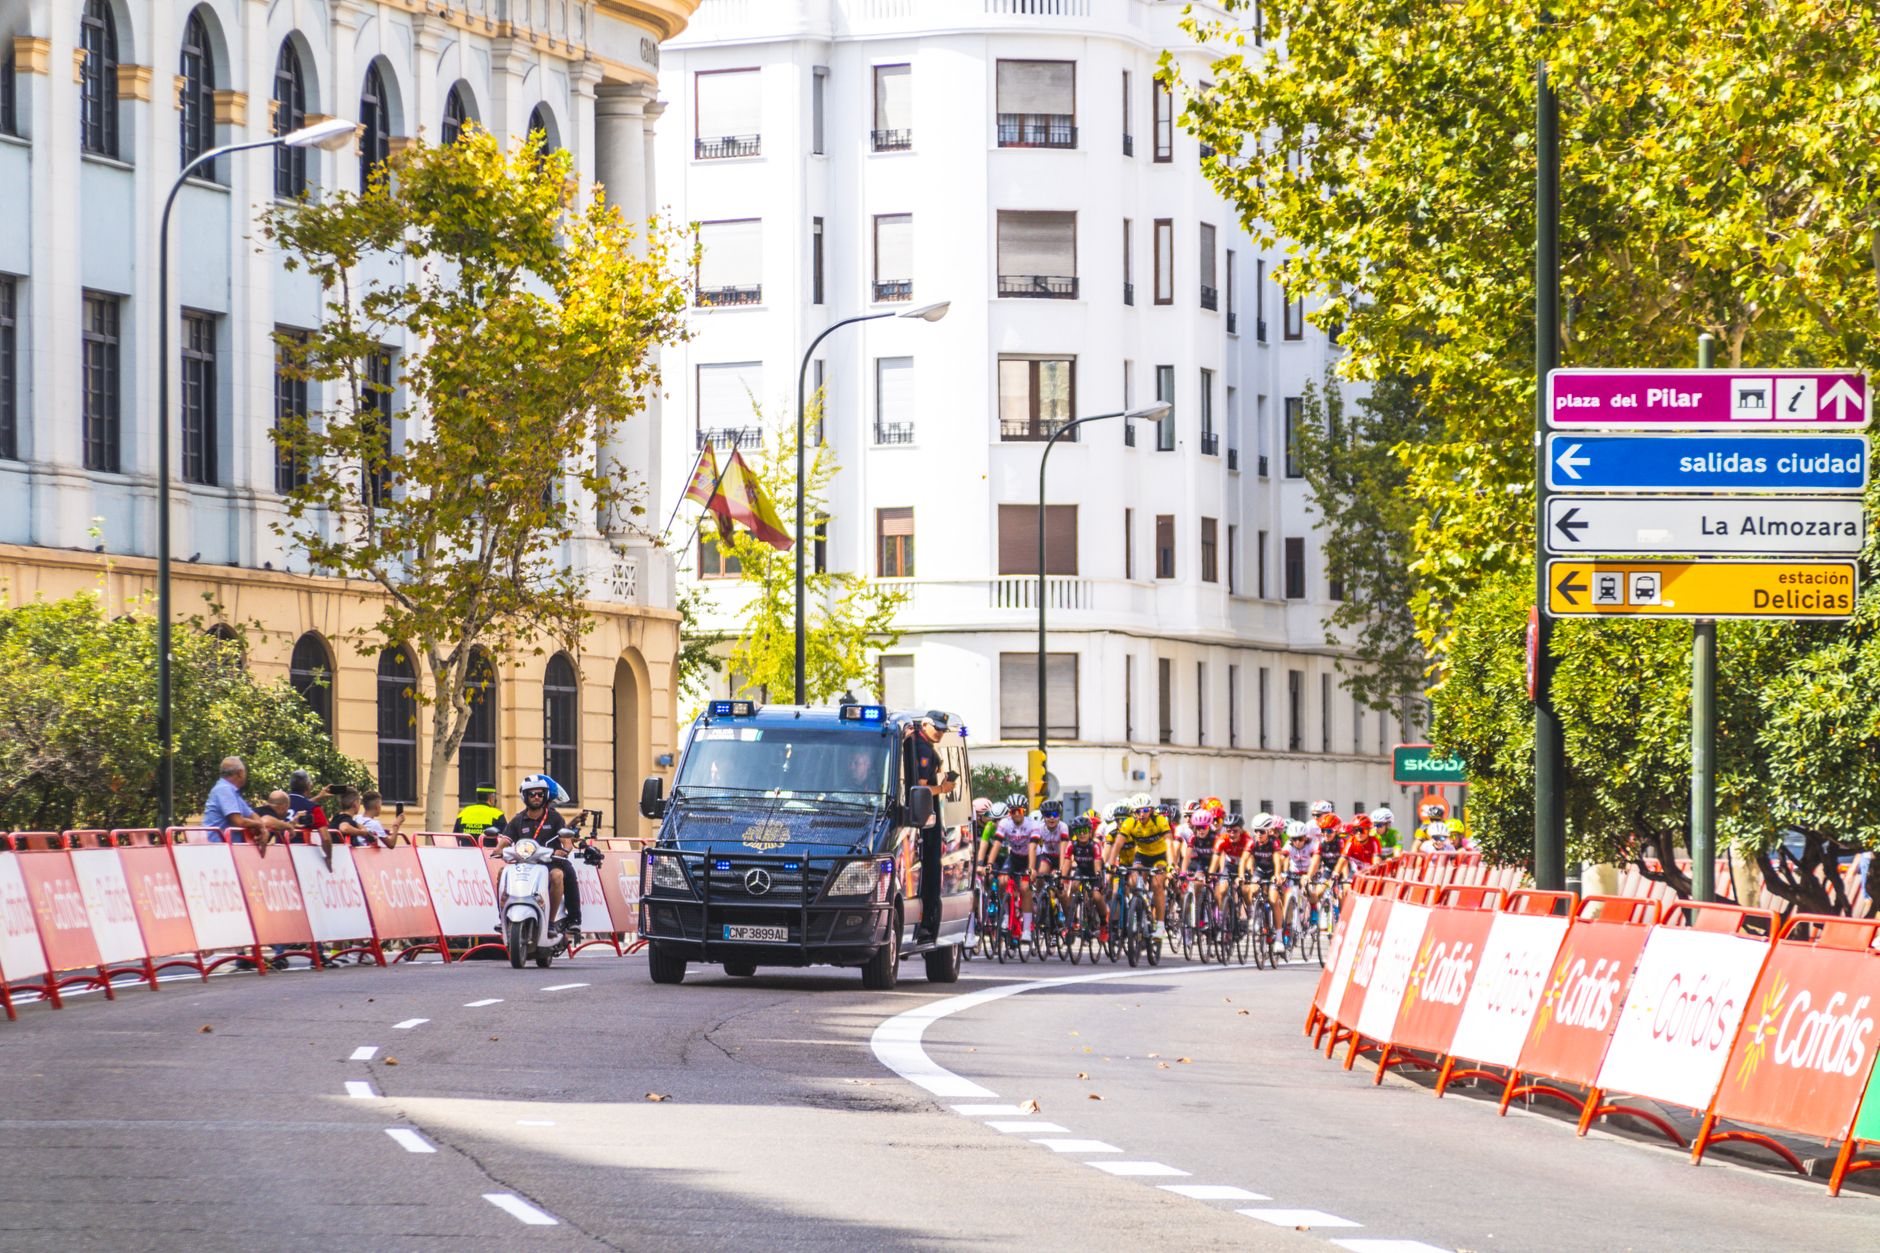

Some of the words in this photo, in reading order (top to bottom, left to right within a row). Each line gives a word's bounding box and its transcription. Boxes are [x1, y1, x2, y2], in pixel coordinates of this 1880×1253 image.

[1556, 394, 1600, 410] plaza
[1610, 393, 1637, 408] del
[1647, 388, 1703, 408] Pilar
[1679, 452, 1768, 473] salidas
[1776, 453, 1861, 474] ciudad
[1701, 516, 1729, 536] La
[1740, 516, 1858, 537] Almozara
[1778, 570, 1850, 586] estación
[1753, 588, 1850, 610] Delicias
[1774, 990, 1874, 1077] Cofidis
